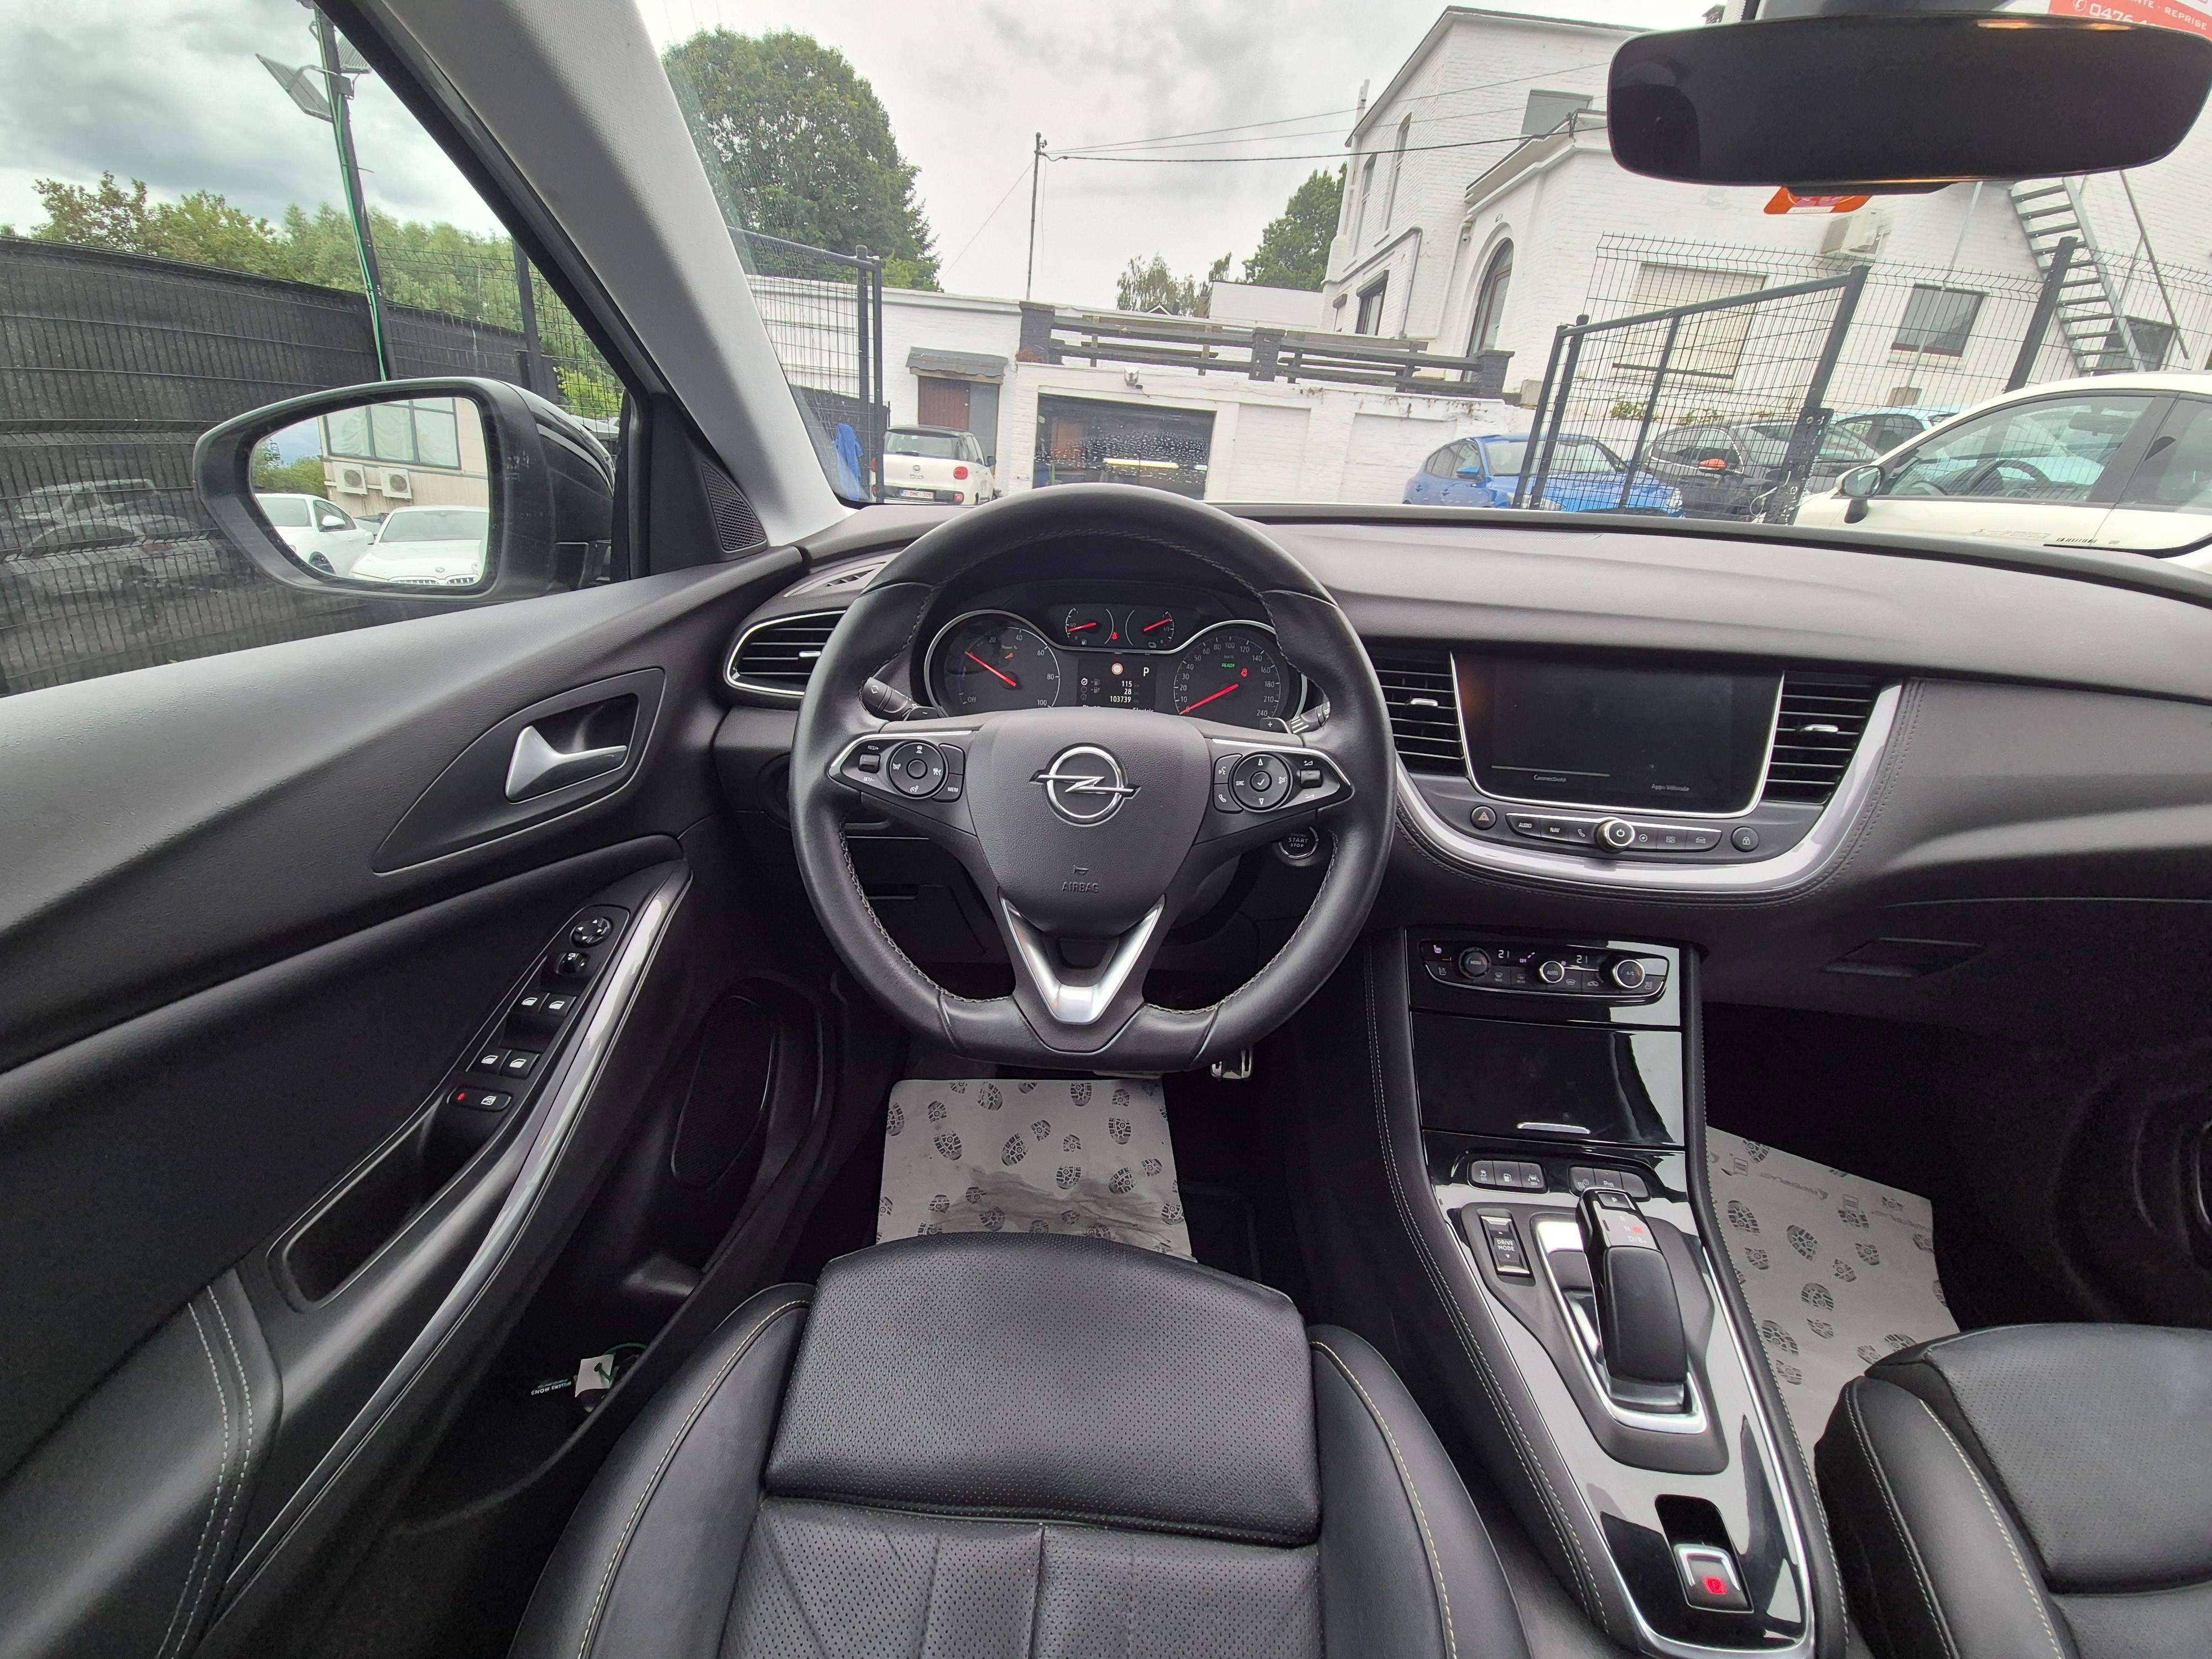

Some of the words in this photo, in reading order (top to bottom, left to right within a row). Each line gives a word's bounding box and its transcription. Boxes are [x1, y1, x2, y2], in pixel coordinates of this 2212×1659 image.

[2164, 7, 2208, 30] REPRISE
[1143, 667, 1149, 677] P
[1062, 881, 1099, 893] AIRBAG
[1498, 950, 1510, 959] 21
[1576, 954, 1588, 964] 21
